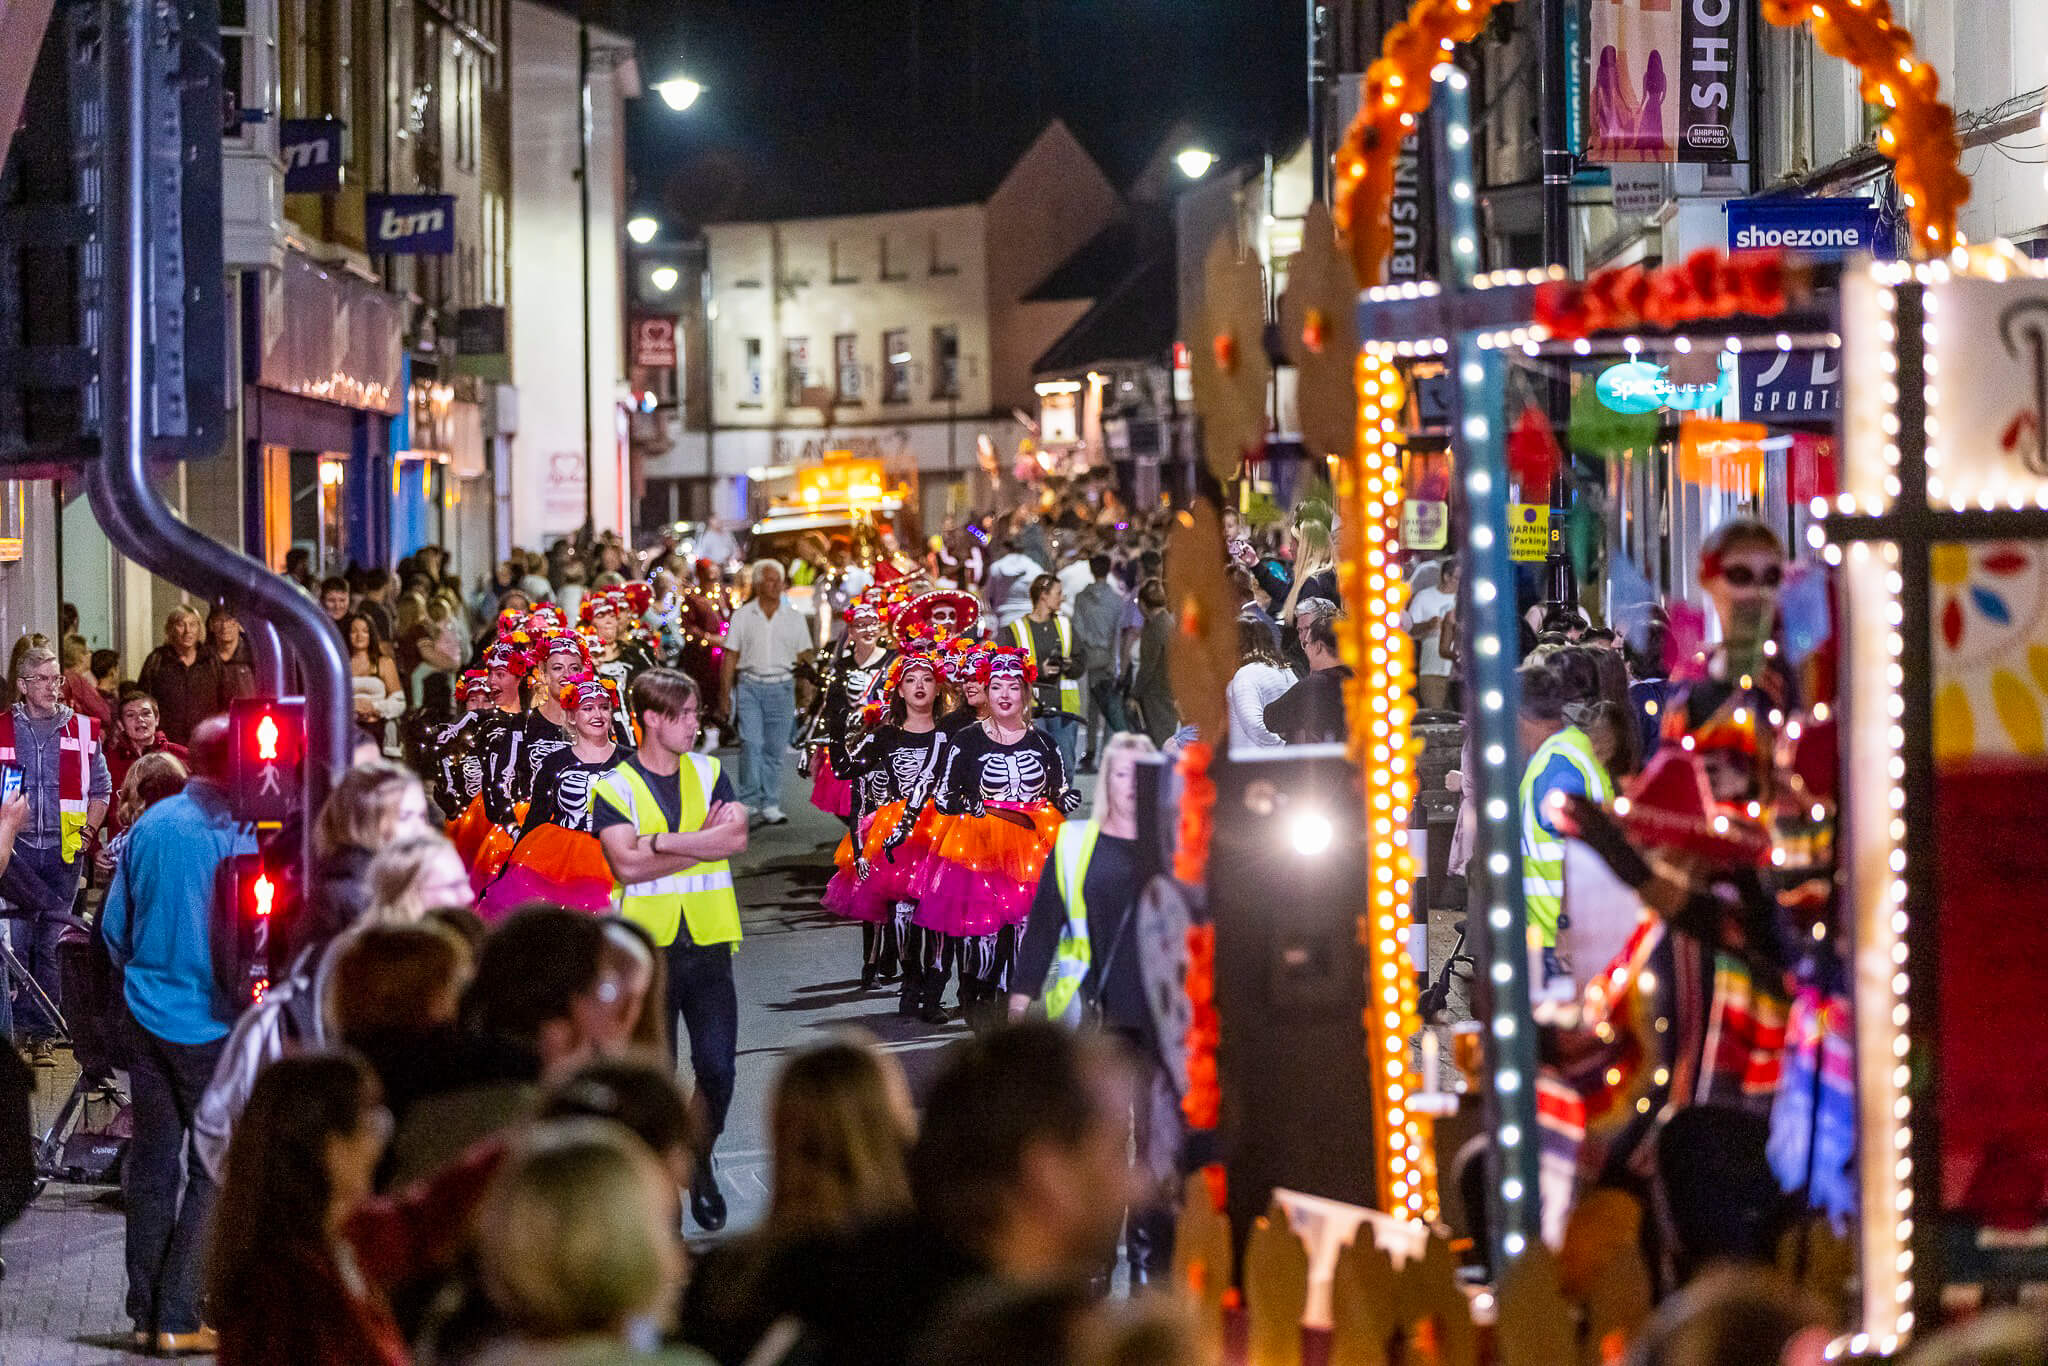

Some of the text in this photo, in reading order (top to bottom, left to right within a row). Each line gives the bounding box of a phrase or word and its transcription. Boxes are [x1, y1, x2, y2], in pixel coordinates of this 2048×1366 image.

[1691, 0, 1730, 110] SHO
[1694, 129, 1724, 137] SHAPING
[1691, 137, 1726, 145] NEWPORT
[1736, 225, 1859, 248] shoezone
[1551, 529, 1560, 541] 8
[1514, 536, 1547, 546] Parking
